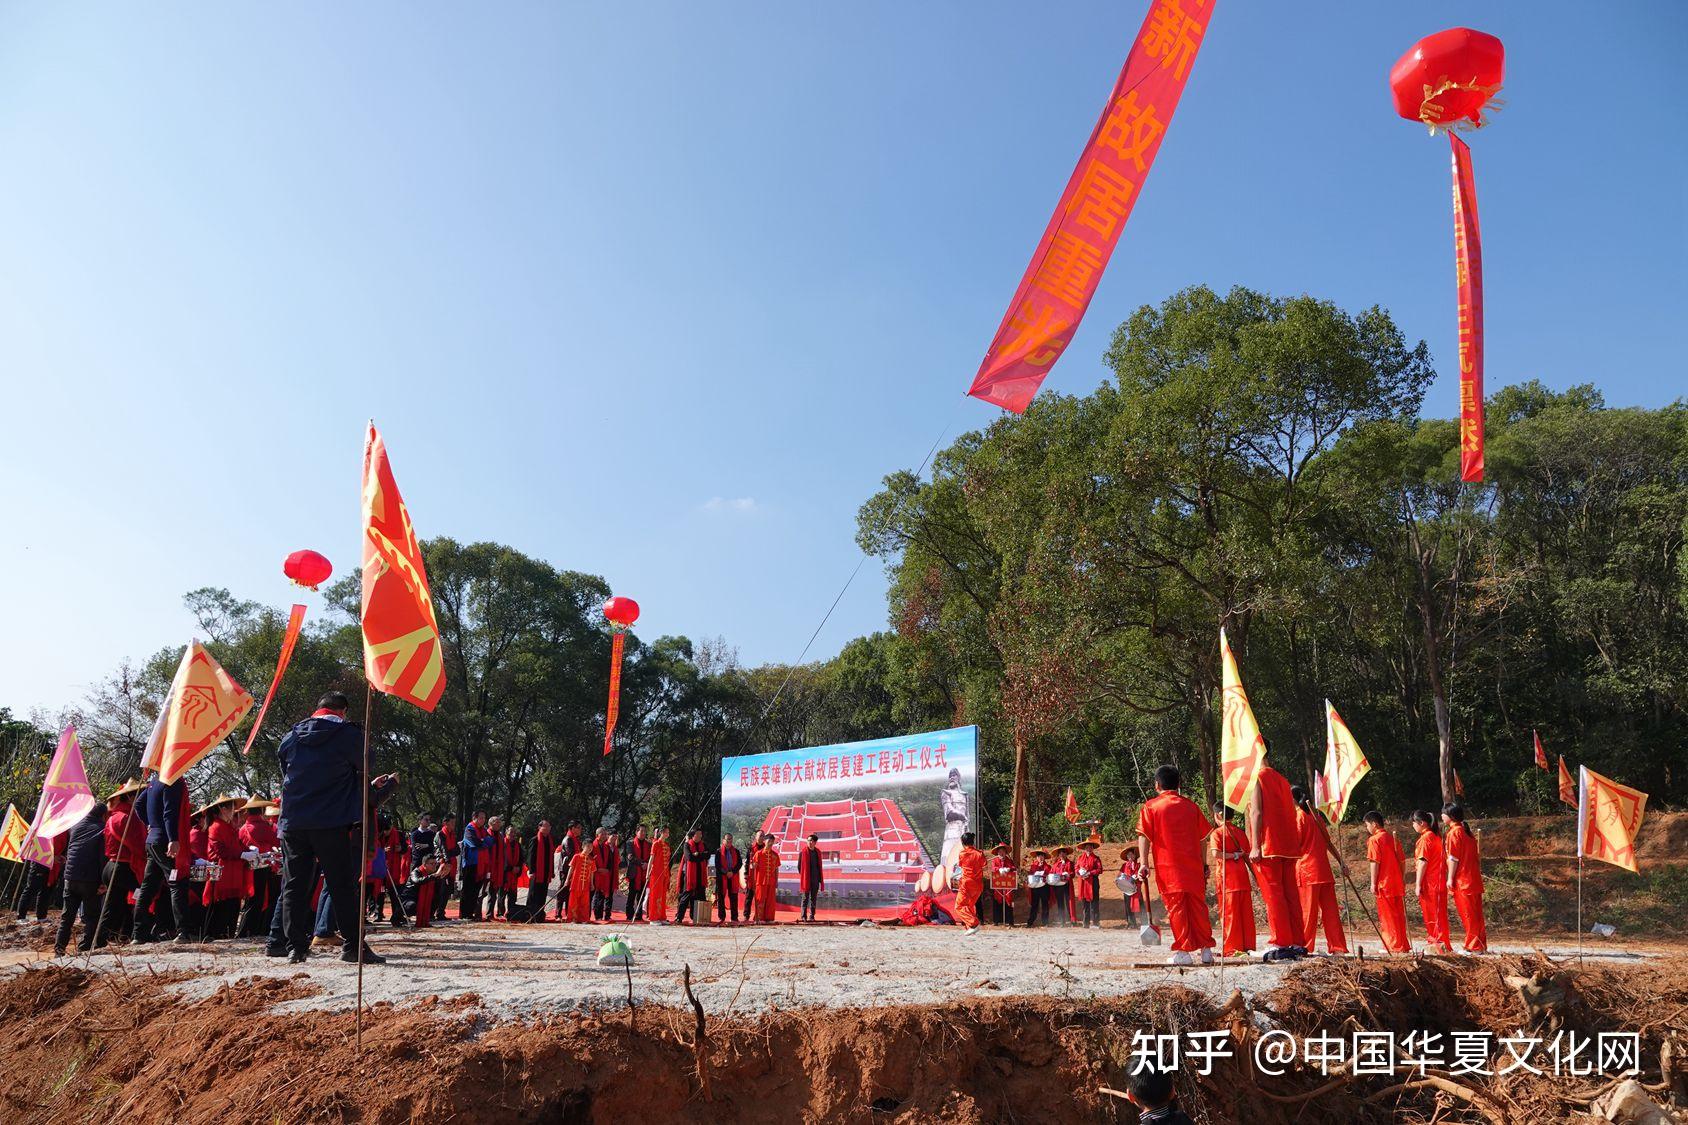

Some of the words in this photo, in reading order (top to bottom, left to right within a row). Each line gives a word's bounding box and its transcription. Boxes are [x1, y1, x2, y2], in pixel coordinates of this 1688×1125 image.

[998, 0, 1204, 367] 新故居重光
[740, 744, 947, 787] 民族英雄俞大猷故居复建工程动工仪式
